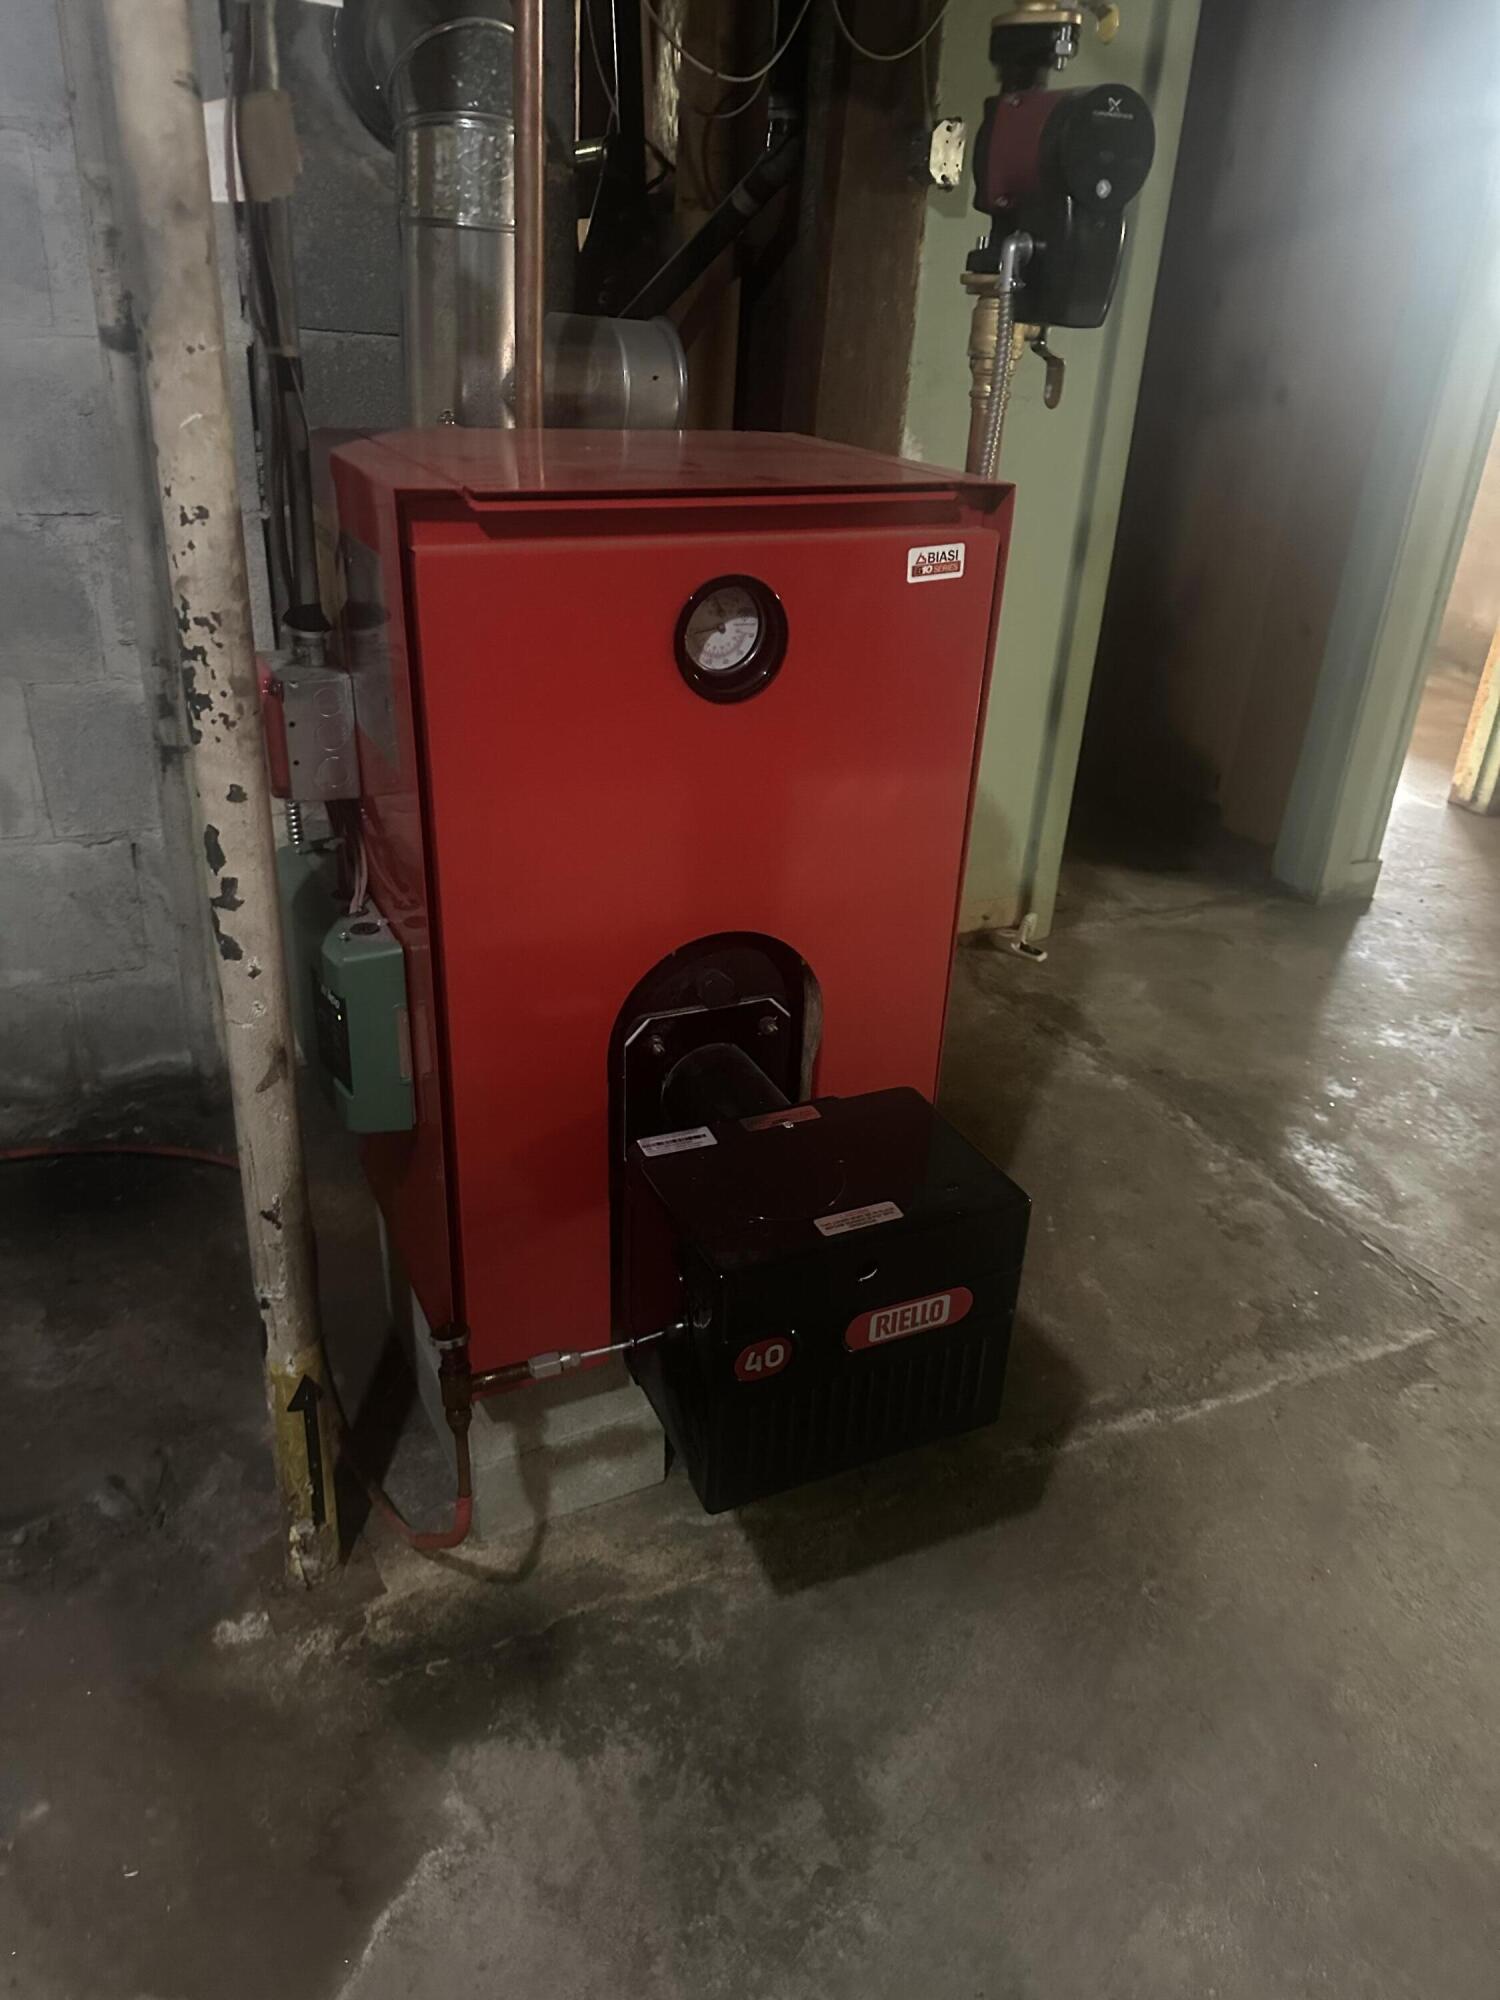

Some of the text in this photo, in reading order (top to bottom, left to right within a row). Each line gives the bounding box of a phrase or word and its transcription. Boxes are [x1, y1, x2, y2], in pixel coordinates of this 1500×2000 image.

[928, 549, 959, 563] BIASI
[876, 1299, 943, 1338] RIELLO
[745, 1344, 784, 1372] 40
